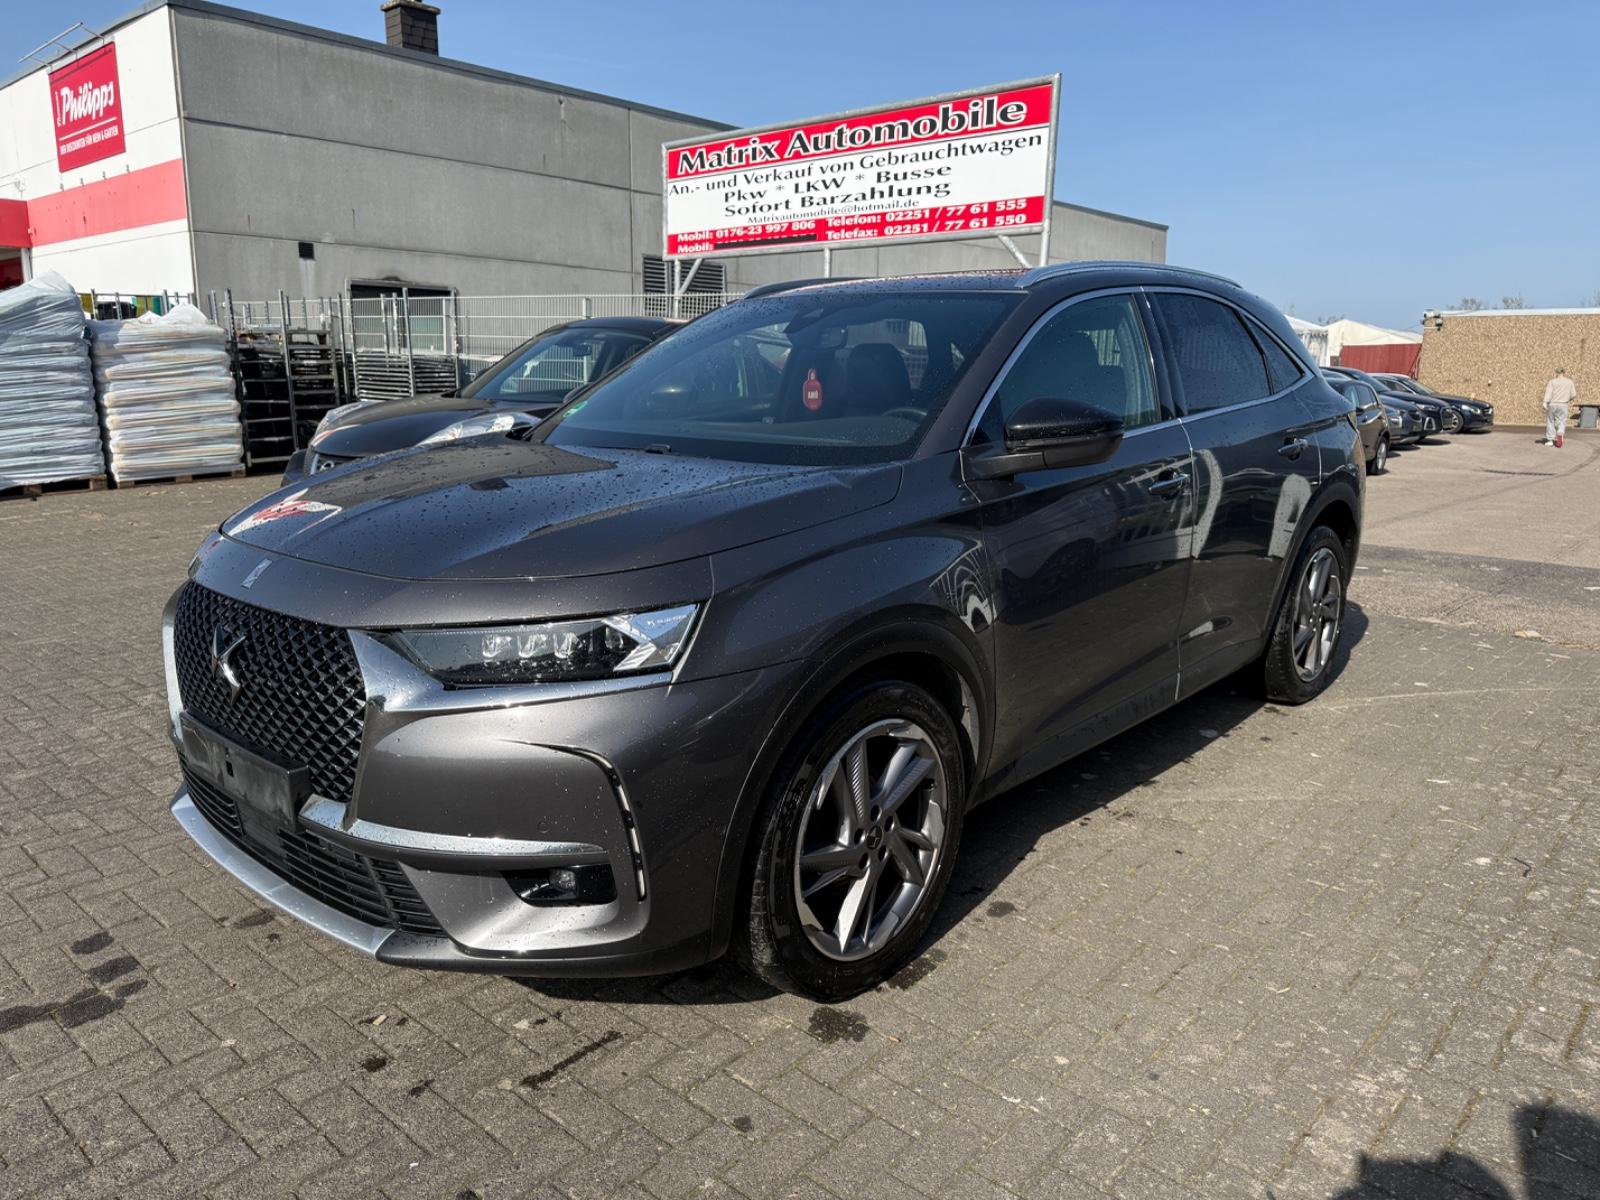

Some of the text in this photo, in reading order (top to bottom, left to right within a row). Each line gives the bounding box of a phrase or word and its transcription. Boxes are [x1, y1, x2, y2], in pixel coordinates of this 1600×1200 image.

[60, 81, 115, 125] Philipps
[677, 96, 1027, 175] Matrix Automobile
[669, 134, 1042, 196] An.- und Verkauf von Gebrauchtwagen
[724, 165, 952, 203] Pkw LKW Busse
[724, 182, 951, 217] Sofort Barzahlung
[747, 199, 919, 225] Matrixautomobile@hotmail.de
[826, 213, 882, 228] Telefon:
[885, 208, 930, 223] 02251
[946, 205, 966, 217] 77
[970, 203, 989, 215] 61
[995, 198, 1027, 211] 555
[826, 227, 878, 240] Telefax:
[884, 222, 928, 235] 02251
[944, 219, 964, 231] 77
[969, 217, 988, 228] 61
[994, 213, 1027, 225] 550
[677, 229, 713, 242] Mobil:
[716, 225, 763, 239] 0176-23
[766, 222, 788, 234] 997
[792, 219, 816, 231] 806
[677, 241, 714, 253] Mobil:
